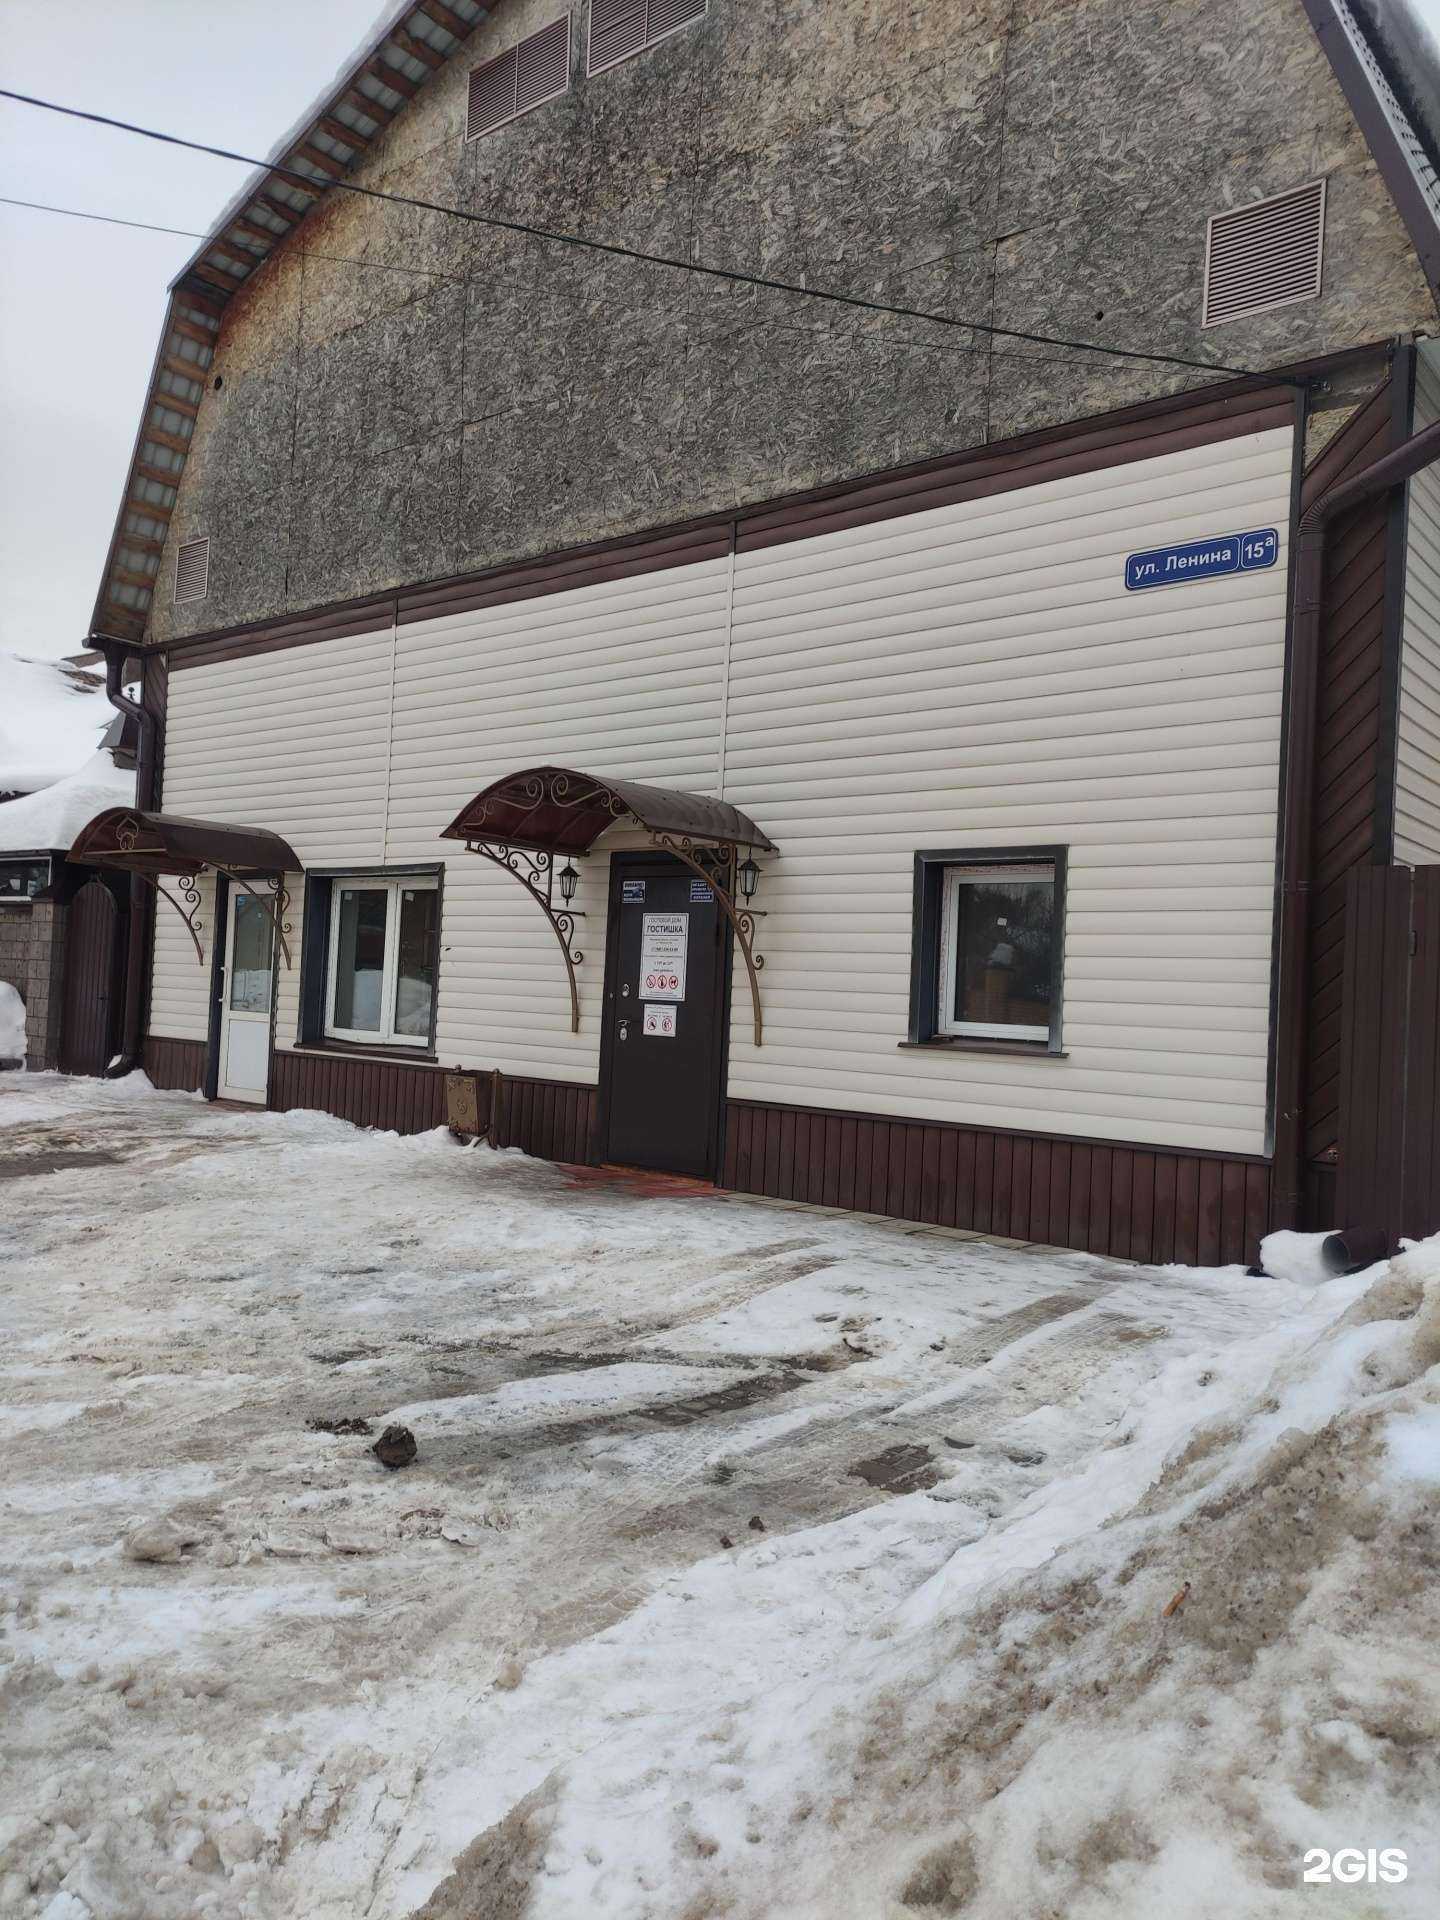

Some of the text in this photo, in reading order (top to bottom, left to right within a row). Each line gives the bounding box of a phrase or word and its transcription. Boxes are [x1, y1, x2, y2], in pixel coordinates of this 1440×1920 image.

[1135, 563, 1160, 579] ул.
[1165, 549, 1232, 571] Ленина
[647, 925, 683, 933] ГОСТИШКА
